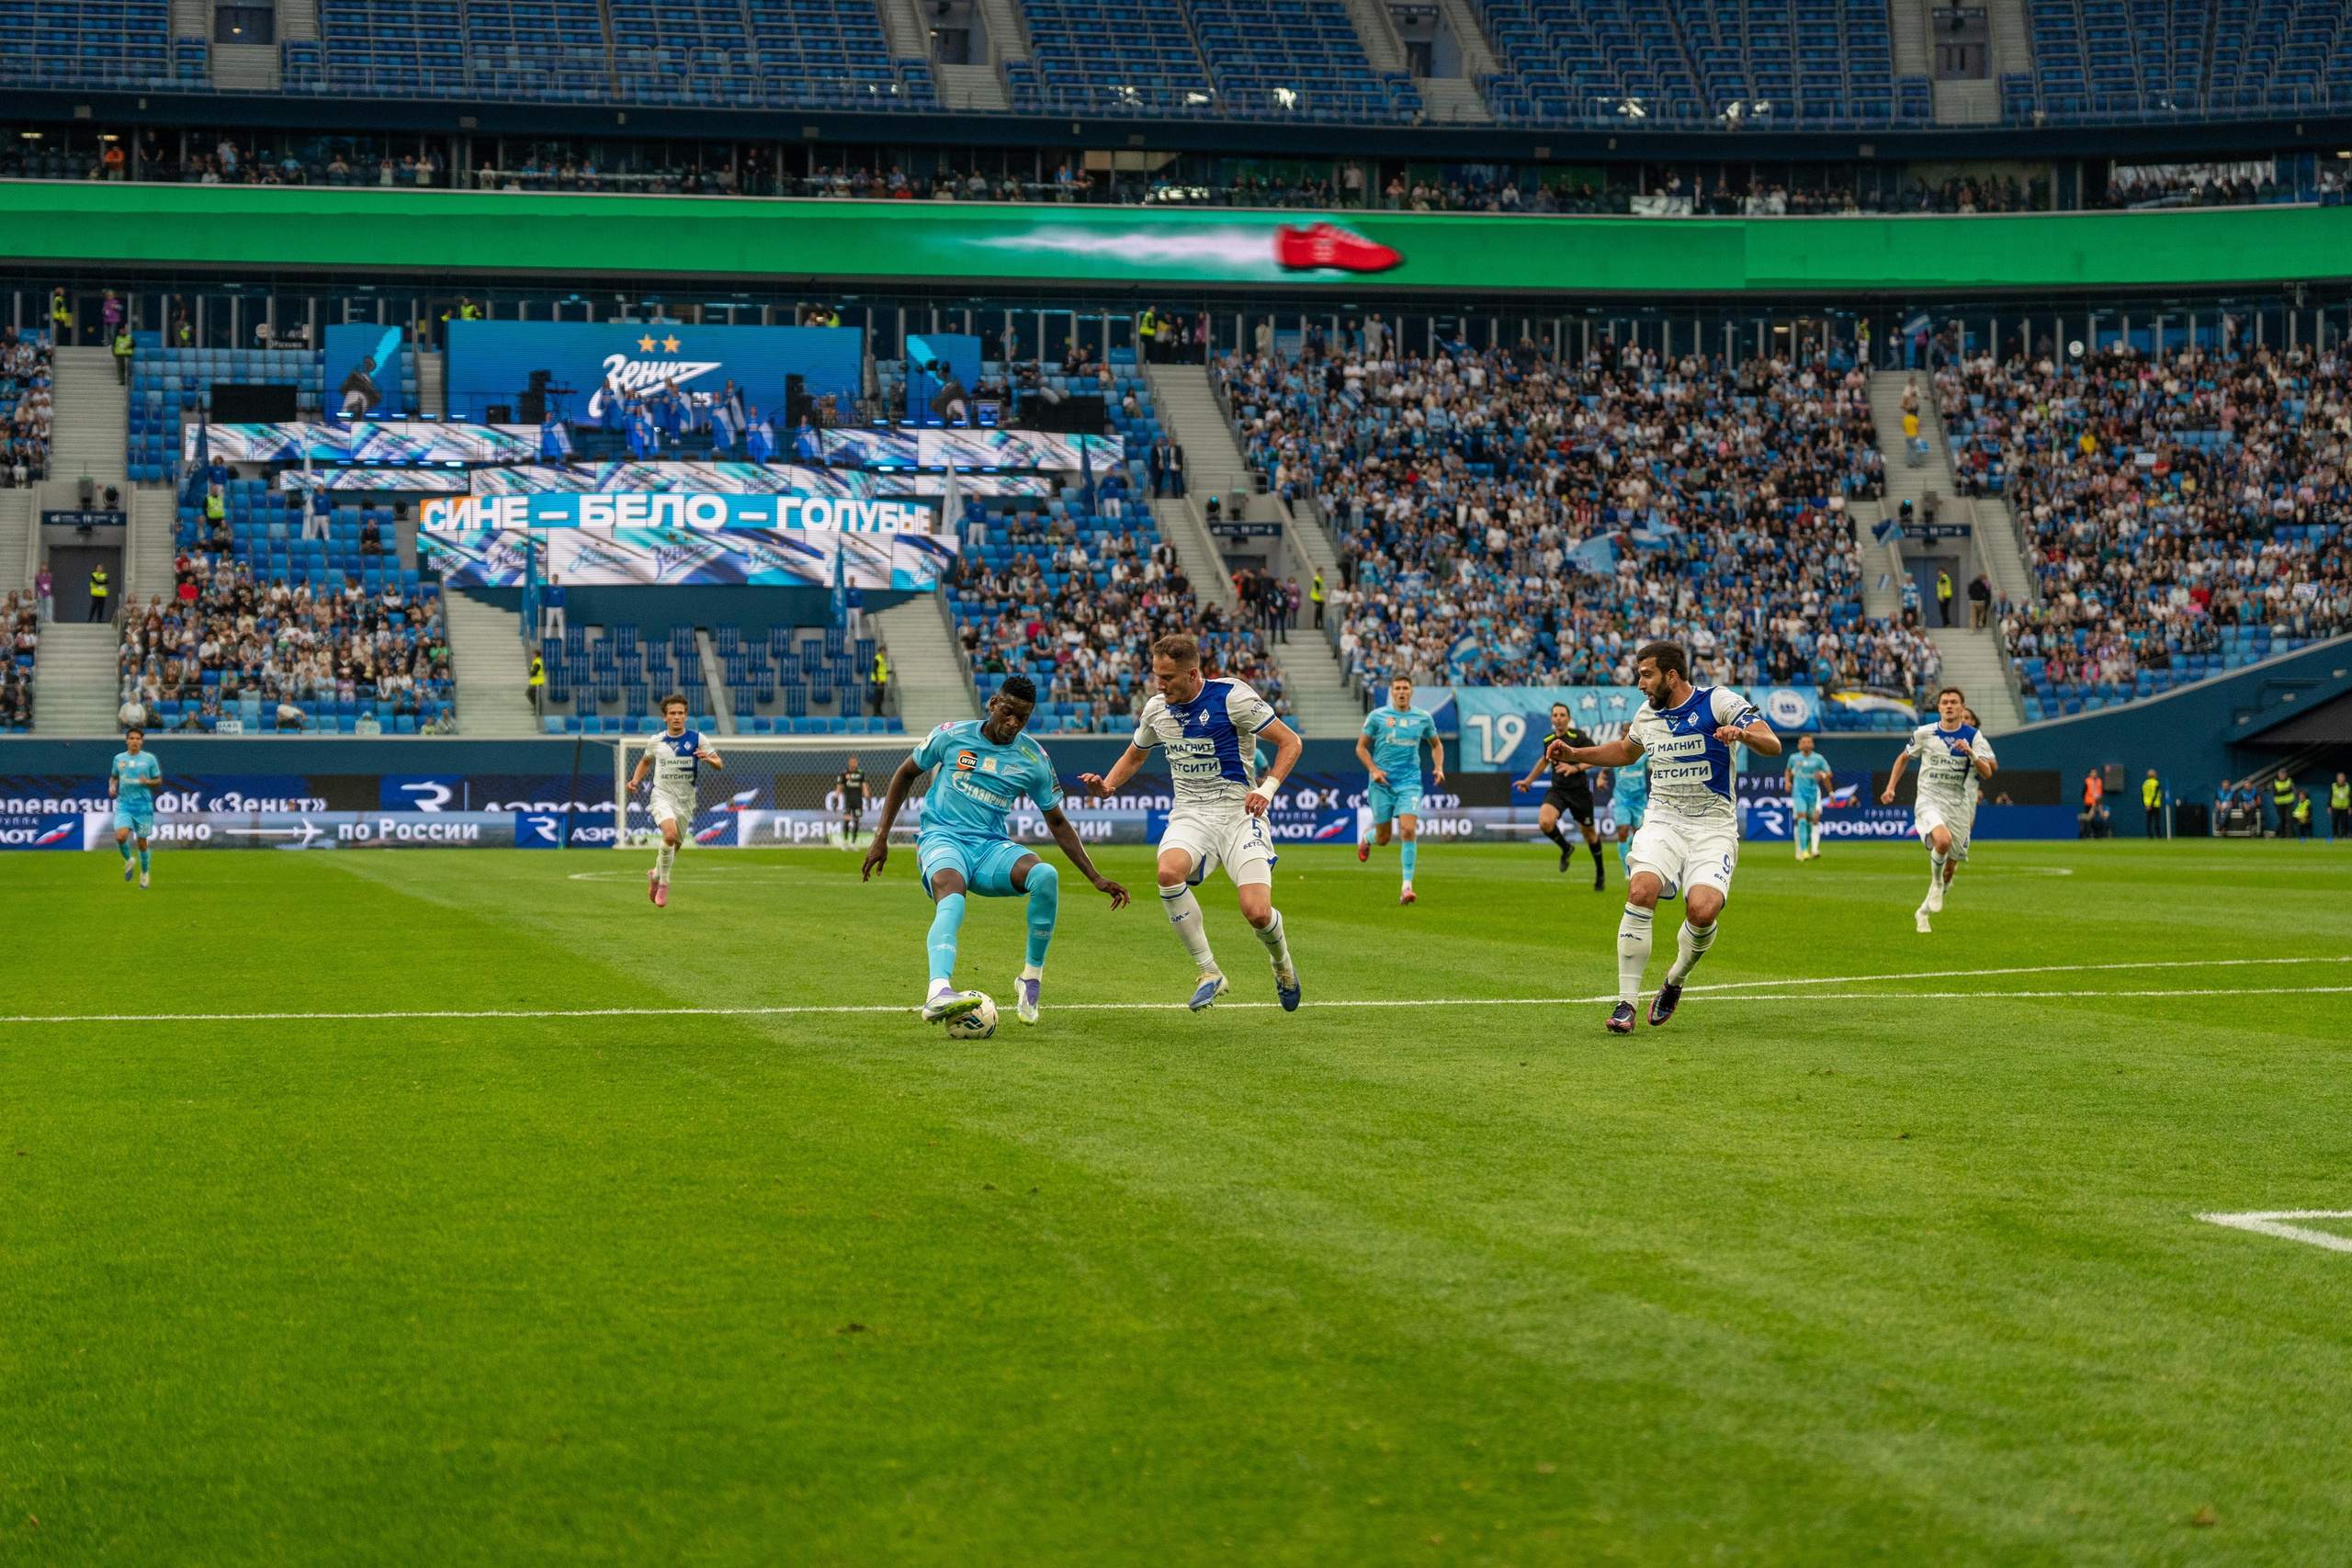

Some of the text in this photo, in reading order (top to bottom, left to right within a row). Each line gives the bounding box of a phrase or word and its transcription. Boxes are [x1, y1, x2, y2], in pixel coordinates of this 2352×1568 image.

[424, 496, 529, 532] СИНЕ
[579, 493, 729, 533] БЕЛО
[776, 496, 932, 535] ГОЛУБЫЕ
[1170, 742, 1212, 753] МАГНИТ
[1467, 714, 1527, 764] 19
[1657, 739, 1702, 752] МАГНИТ
[961, 757, 977, 766] WIN
[1654, 765, 1709, 779] БЕТСИТИ
[155, 792, 201, 814] ФК
[338, 823, 370, 840] по
[379, 818, 479, 840] России
[1017, 815, 1113, 838] Росии
[1251, 818, 1262, 840] 5
[1723, 853, 1733, 874] 9
